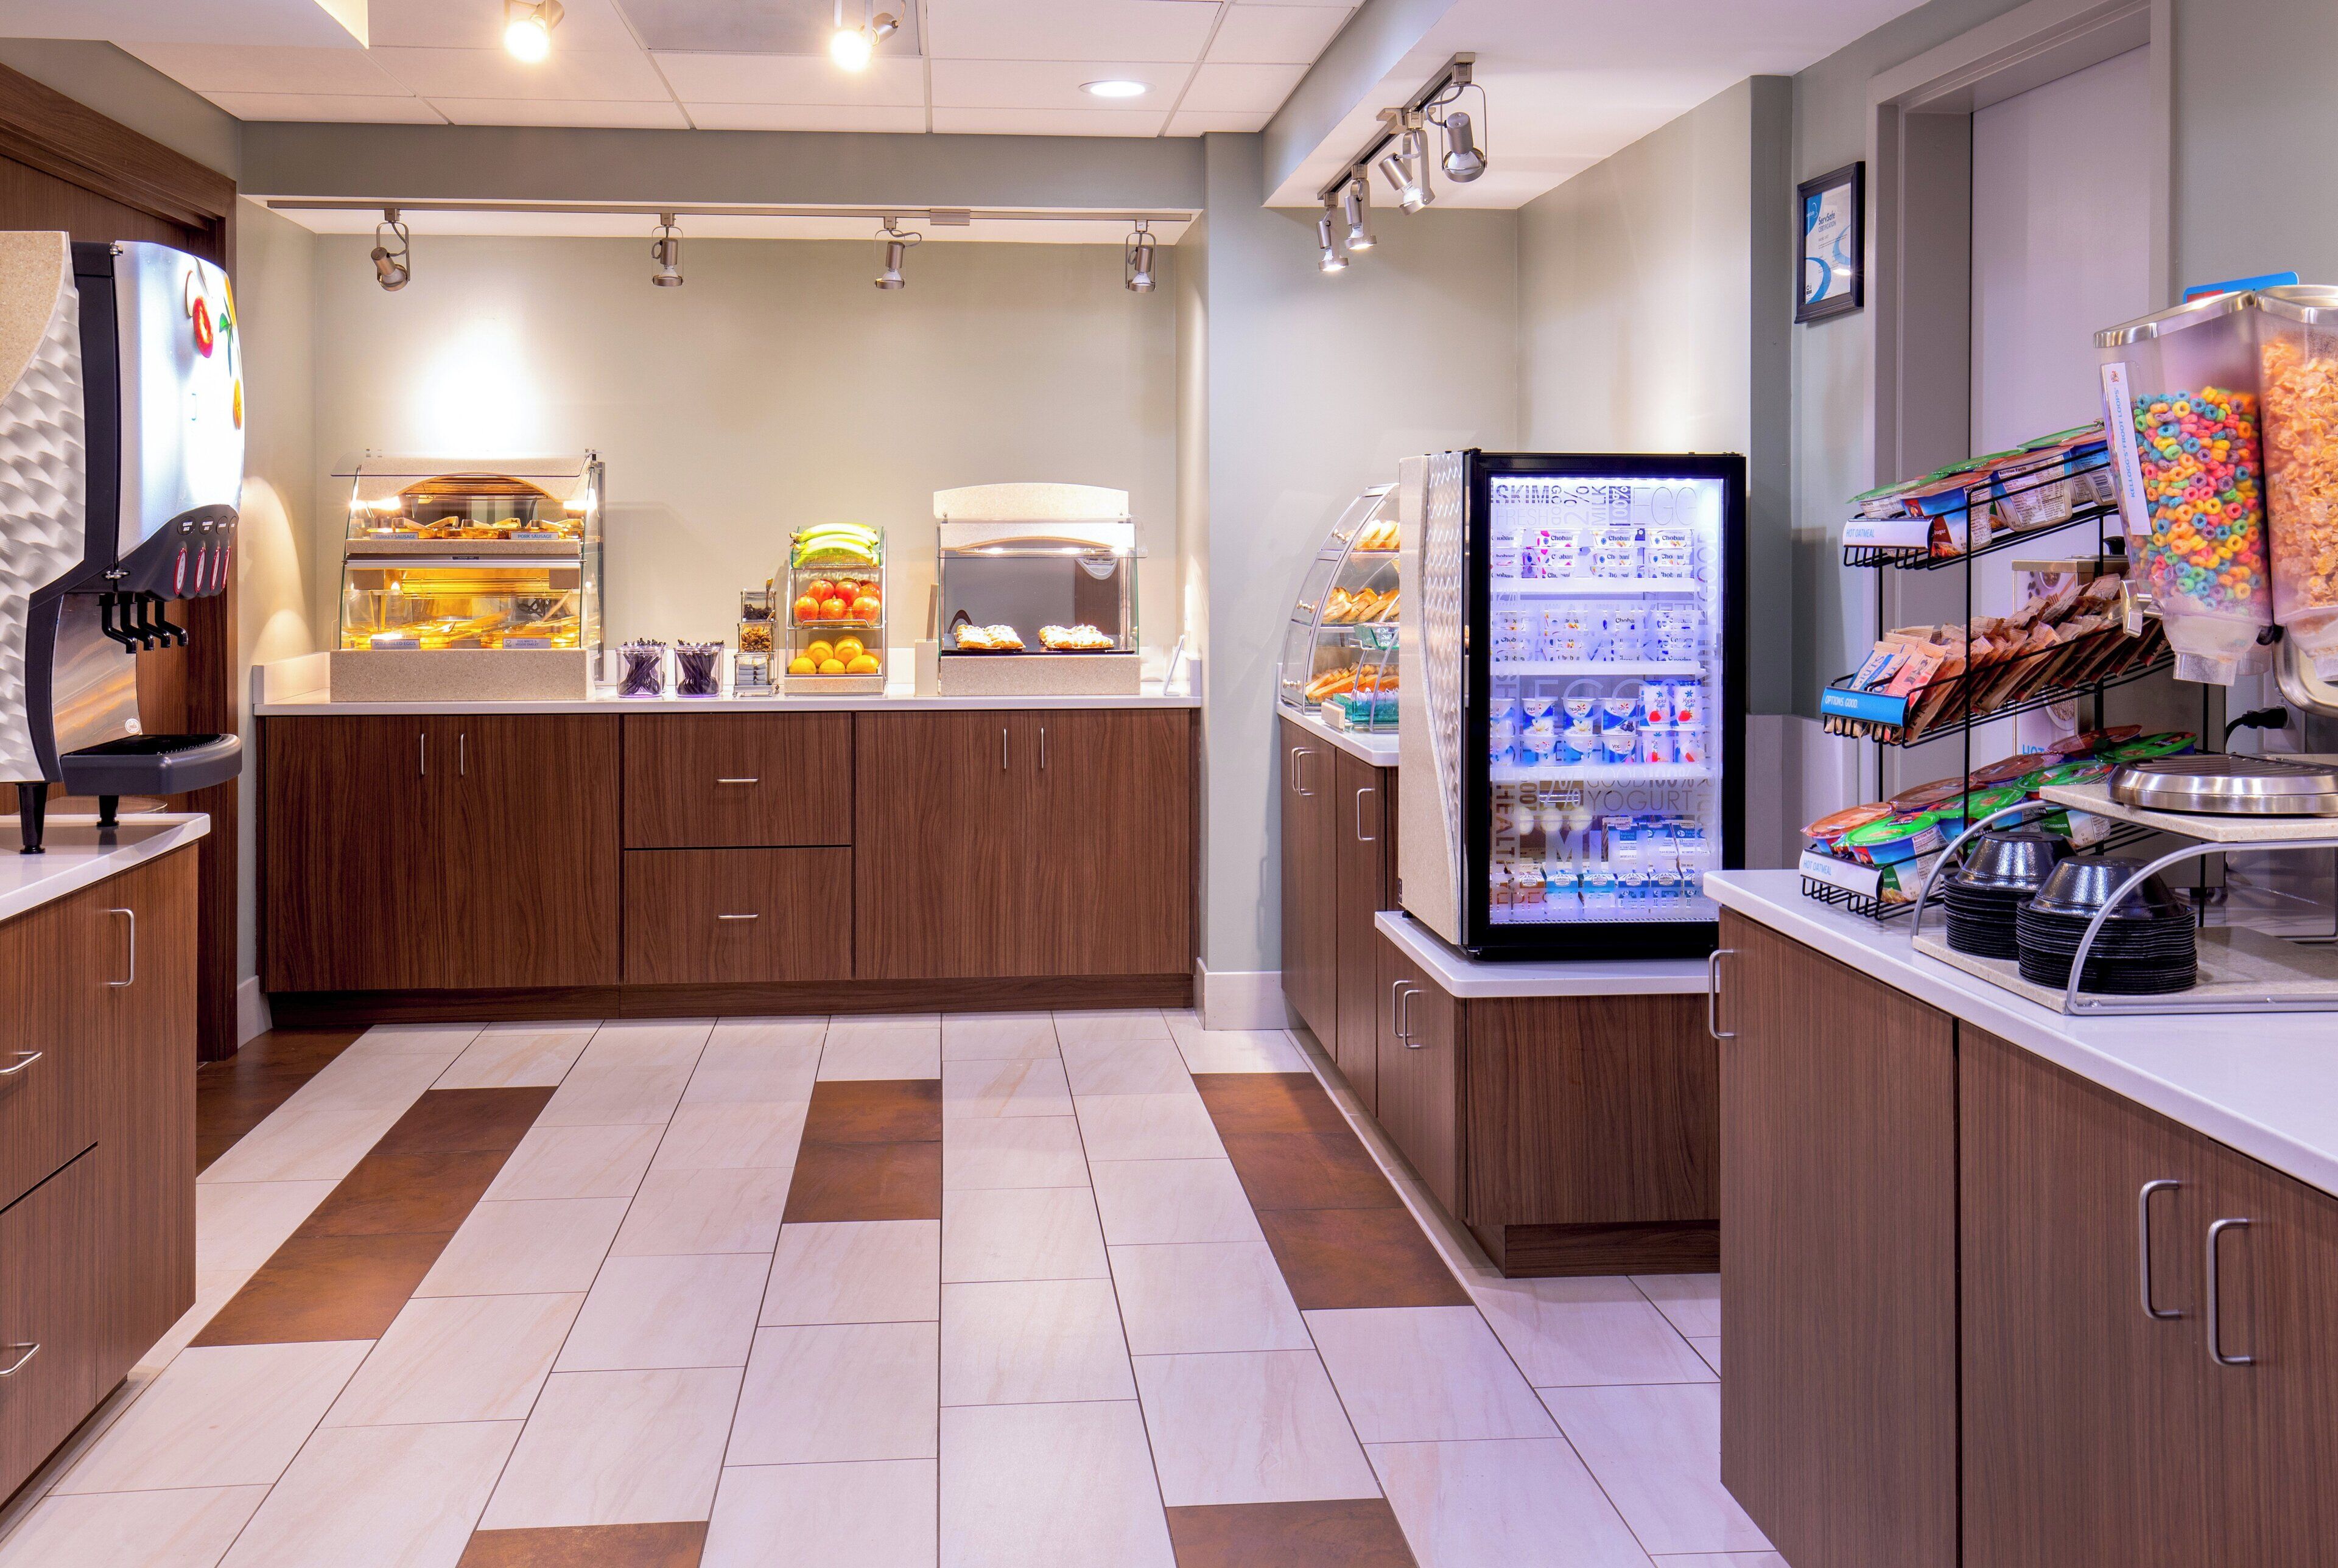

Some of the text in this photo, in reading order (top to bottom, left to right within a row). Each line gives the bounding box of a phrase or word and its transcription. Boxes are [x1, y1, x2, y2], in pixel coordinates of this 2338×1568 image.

[1818, 211, 1835, 225] ServSafe
[1818, 220, 1836, 233] CERTIFICATION
[2113, 389, 2122, 418] LOOPS
[2118, 420, 2128, 449] FROOT
[1496, 485, 1550, 504] SKIM
[1591, 485, 1607, 525] MILK
[1496, 506, 1549, 526] FRESH
[1611, 486, 1630, 526] 100%
[1855, 529, 1875, 537] OATMEAL
[1853, 655, 1885, 688] GRITS
[1825, 695, 1858, 709] OPTIONS. GOOD.
[1586, 767, 1646, 788] GOOD
[1649, 767, 1694, 788] 100%
[1587, 790, 1693, 812] YOGURT
[1803, 861, 1832, 876] HOT OATMEAL
